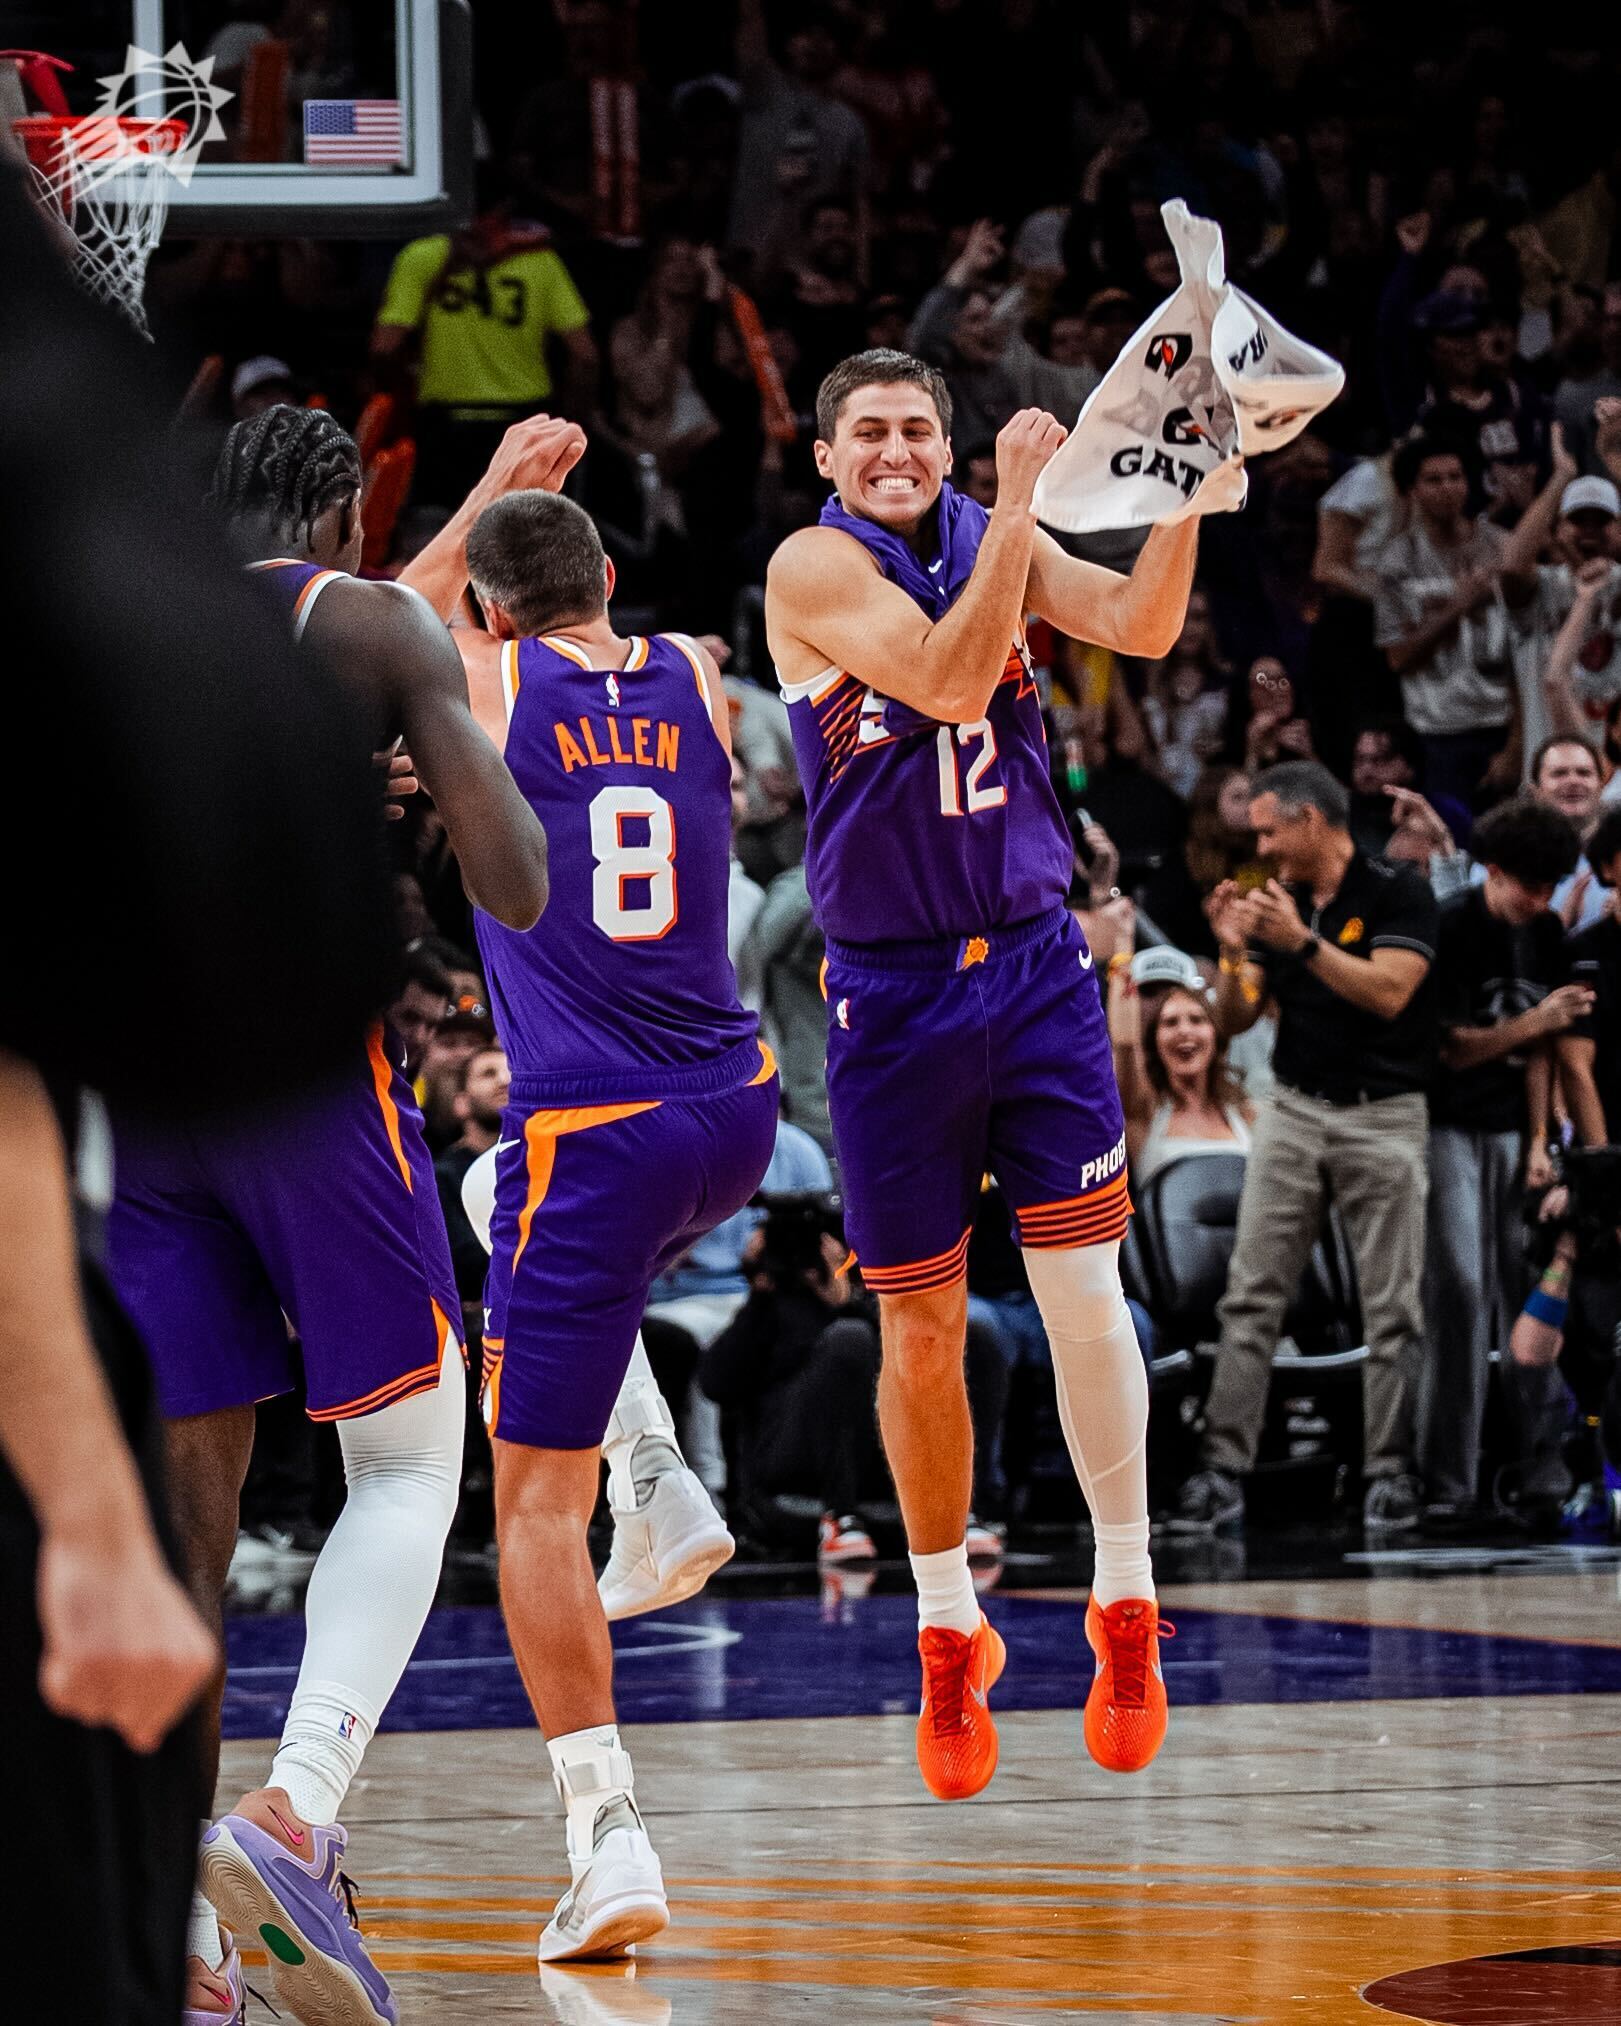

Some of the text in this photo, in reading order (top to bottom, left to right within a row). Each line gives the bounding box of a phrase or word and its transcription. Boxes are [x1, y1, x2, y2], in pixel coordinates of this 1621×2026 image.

[553, 716, 680, 774] ALLEN
[936, 717, 1007, 817] 12
[589, 786, 678, 943] 8
